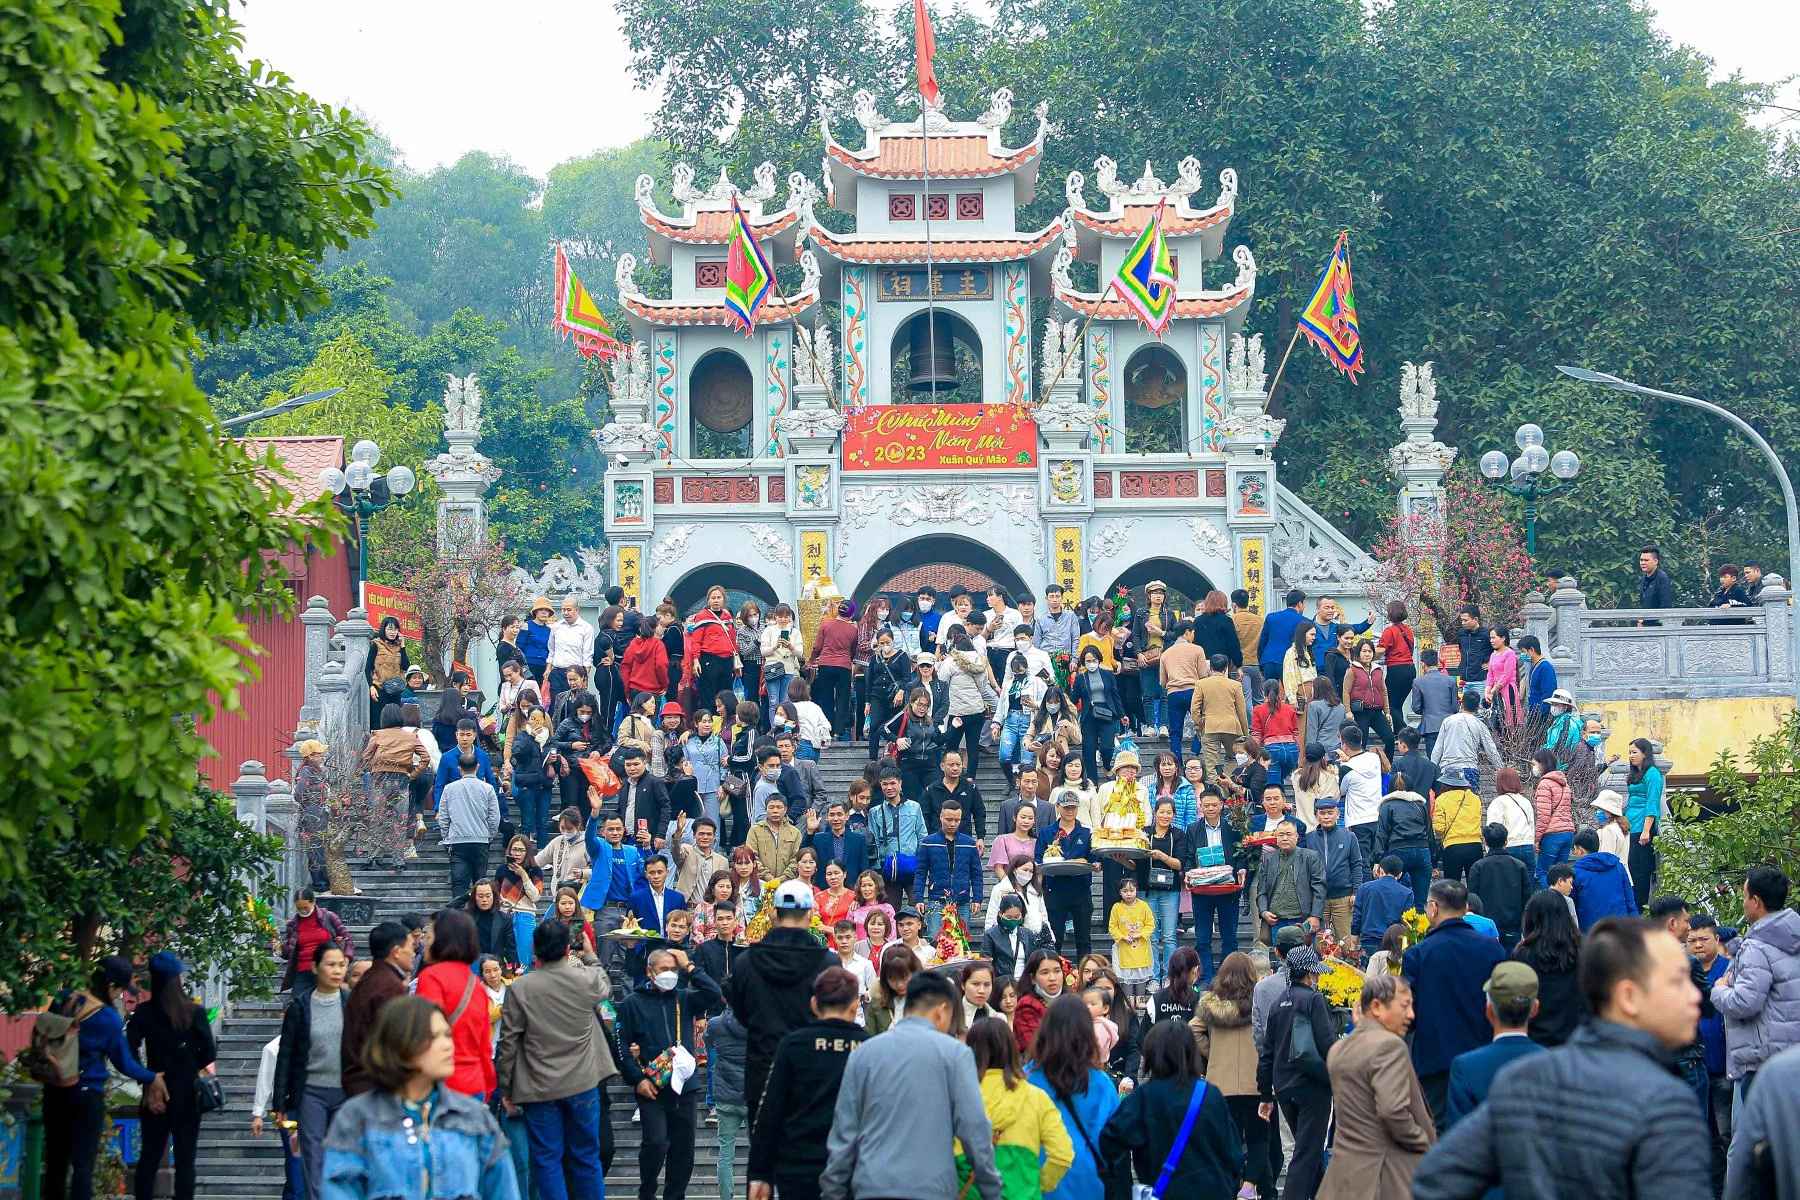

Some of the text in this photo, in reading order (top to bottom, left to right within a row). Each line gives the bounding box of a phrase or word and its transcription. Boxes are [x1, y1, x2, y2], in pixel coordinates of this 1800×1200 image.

[874, 442, 926, 463] 2023
[939, 454, 964, 465] Xuân
[1160, 1003, 1192, 1012] CHANL
